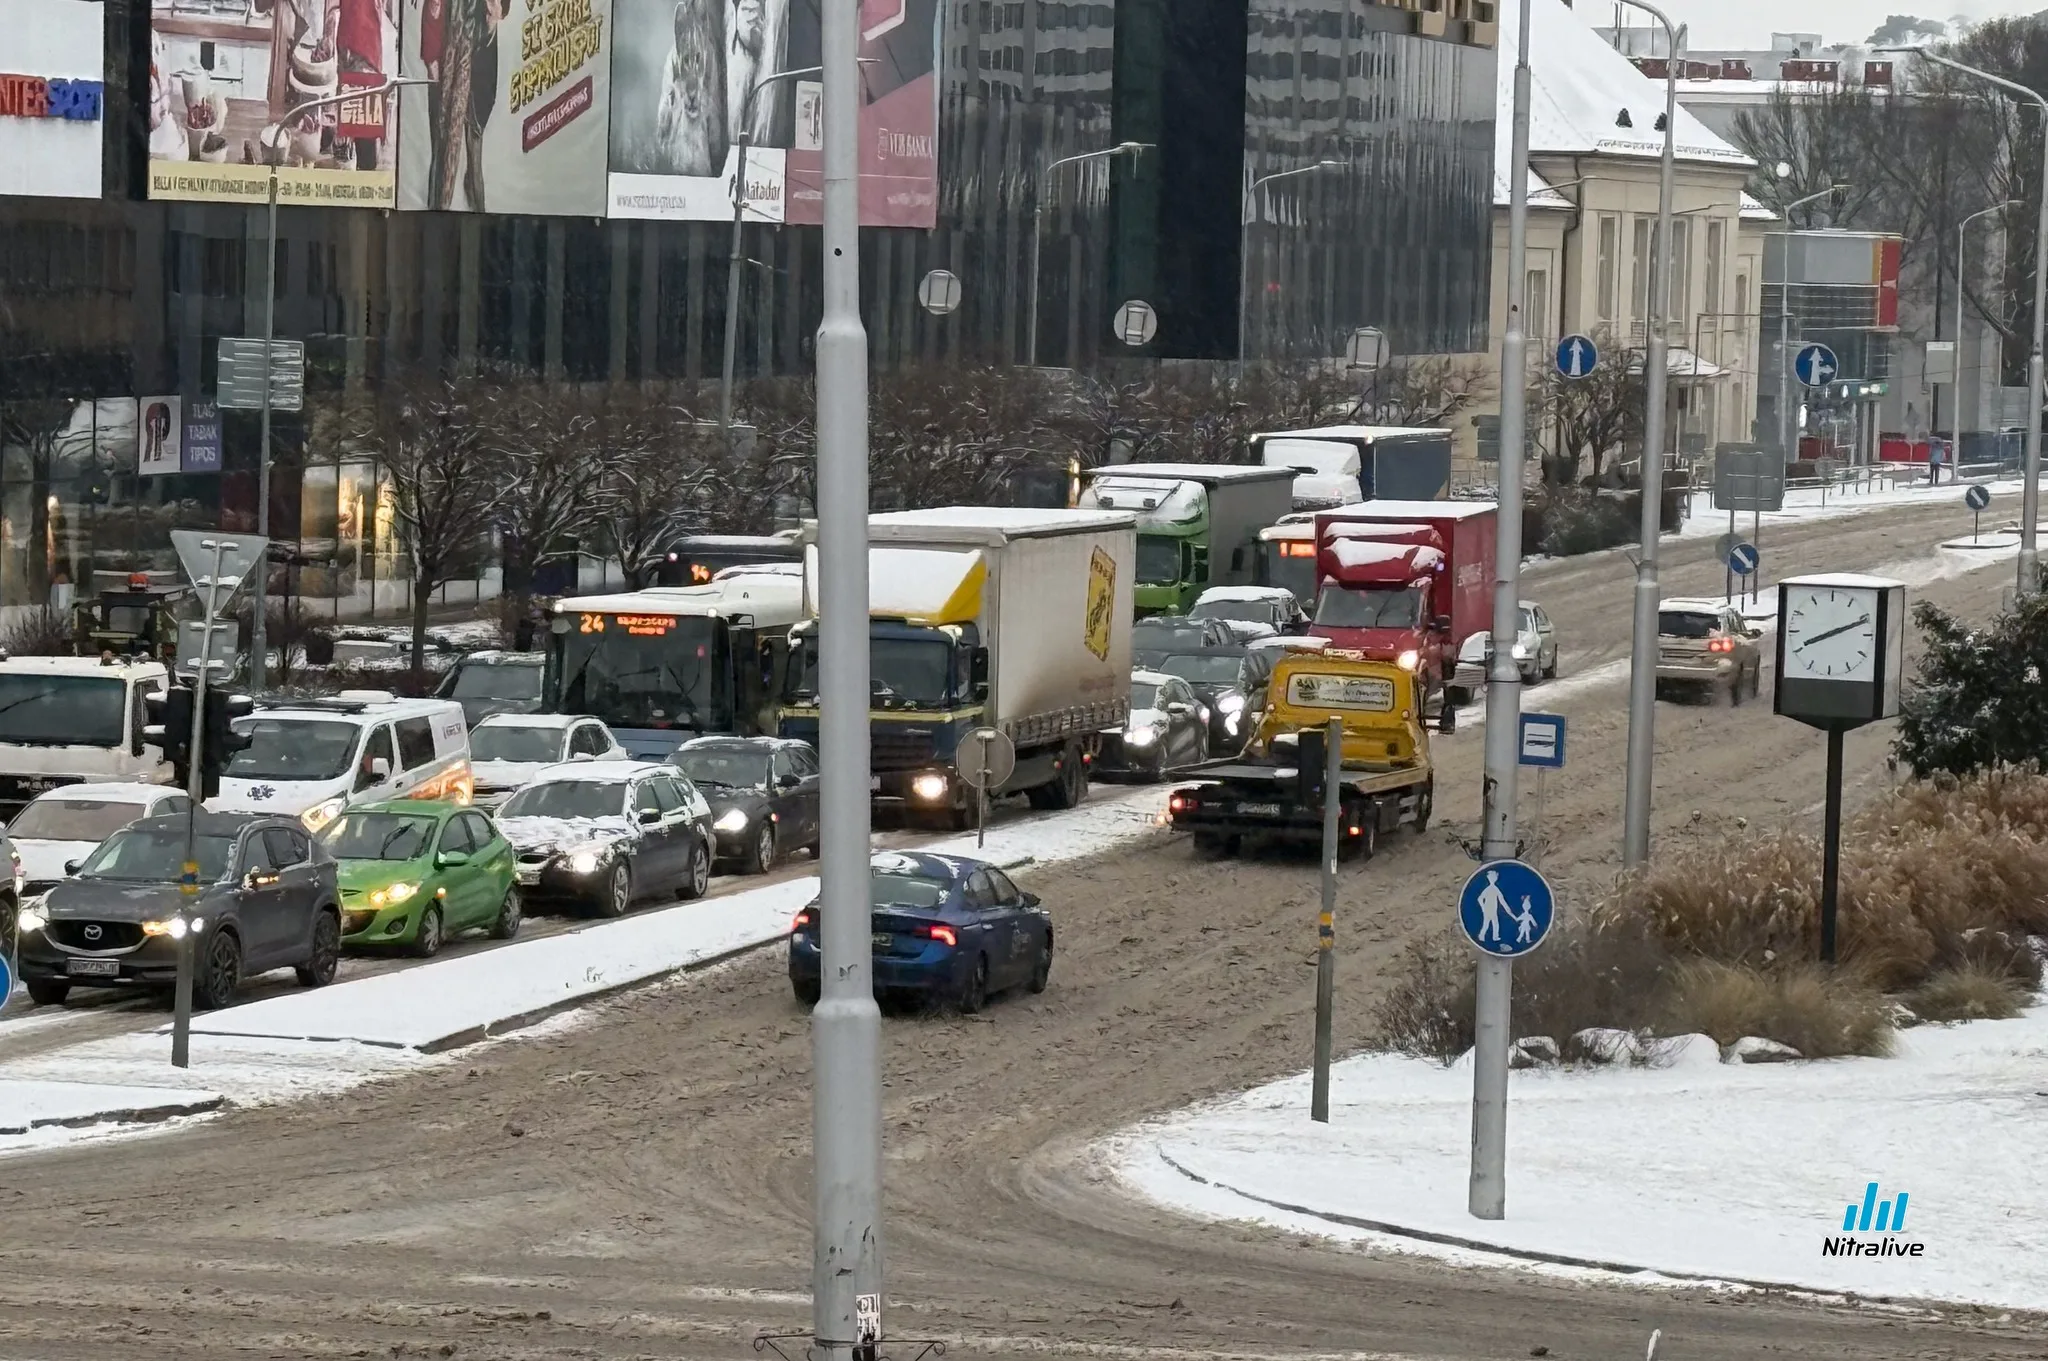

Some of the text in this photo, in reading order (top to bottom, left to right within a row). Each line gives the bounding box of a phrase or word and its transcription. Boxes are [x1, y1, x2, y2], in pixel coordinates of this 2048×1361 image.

[188, 424, 217, 441] TABAK
[190, 446, 216, 462] TIPOS
[580, 614, 605, 634] 24
